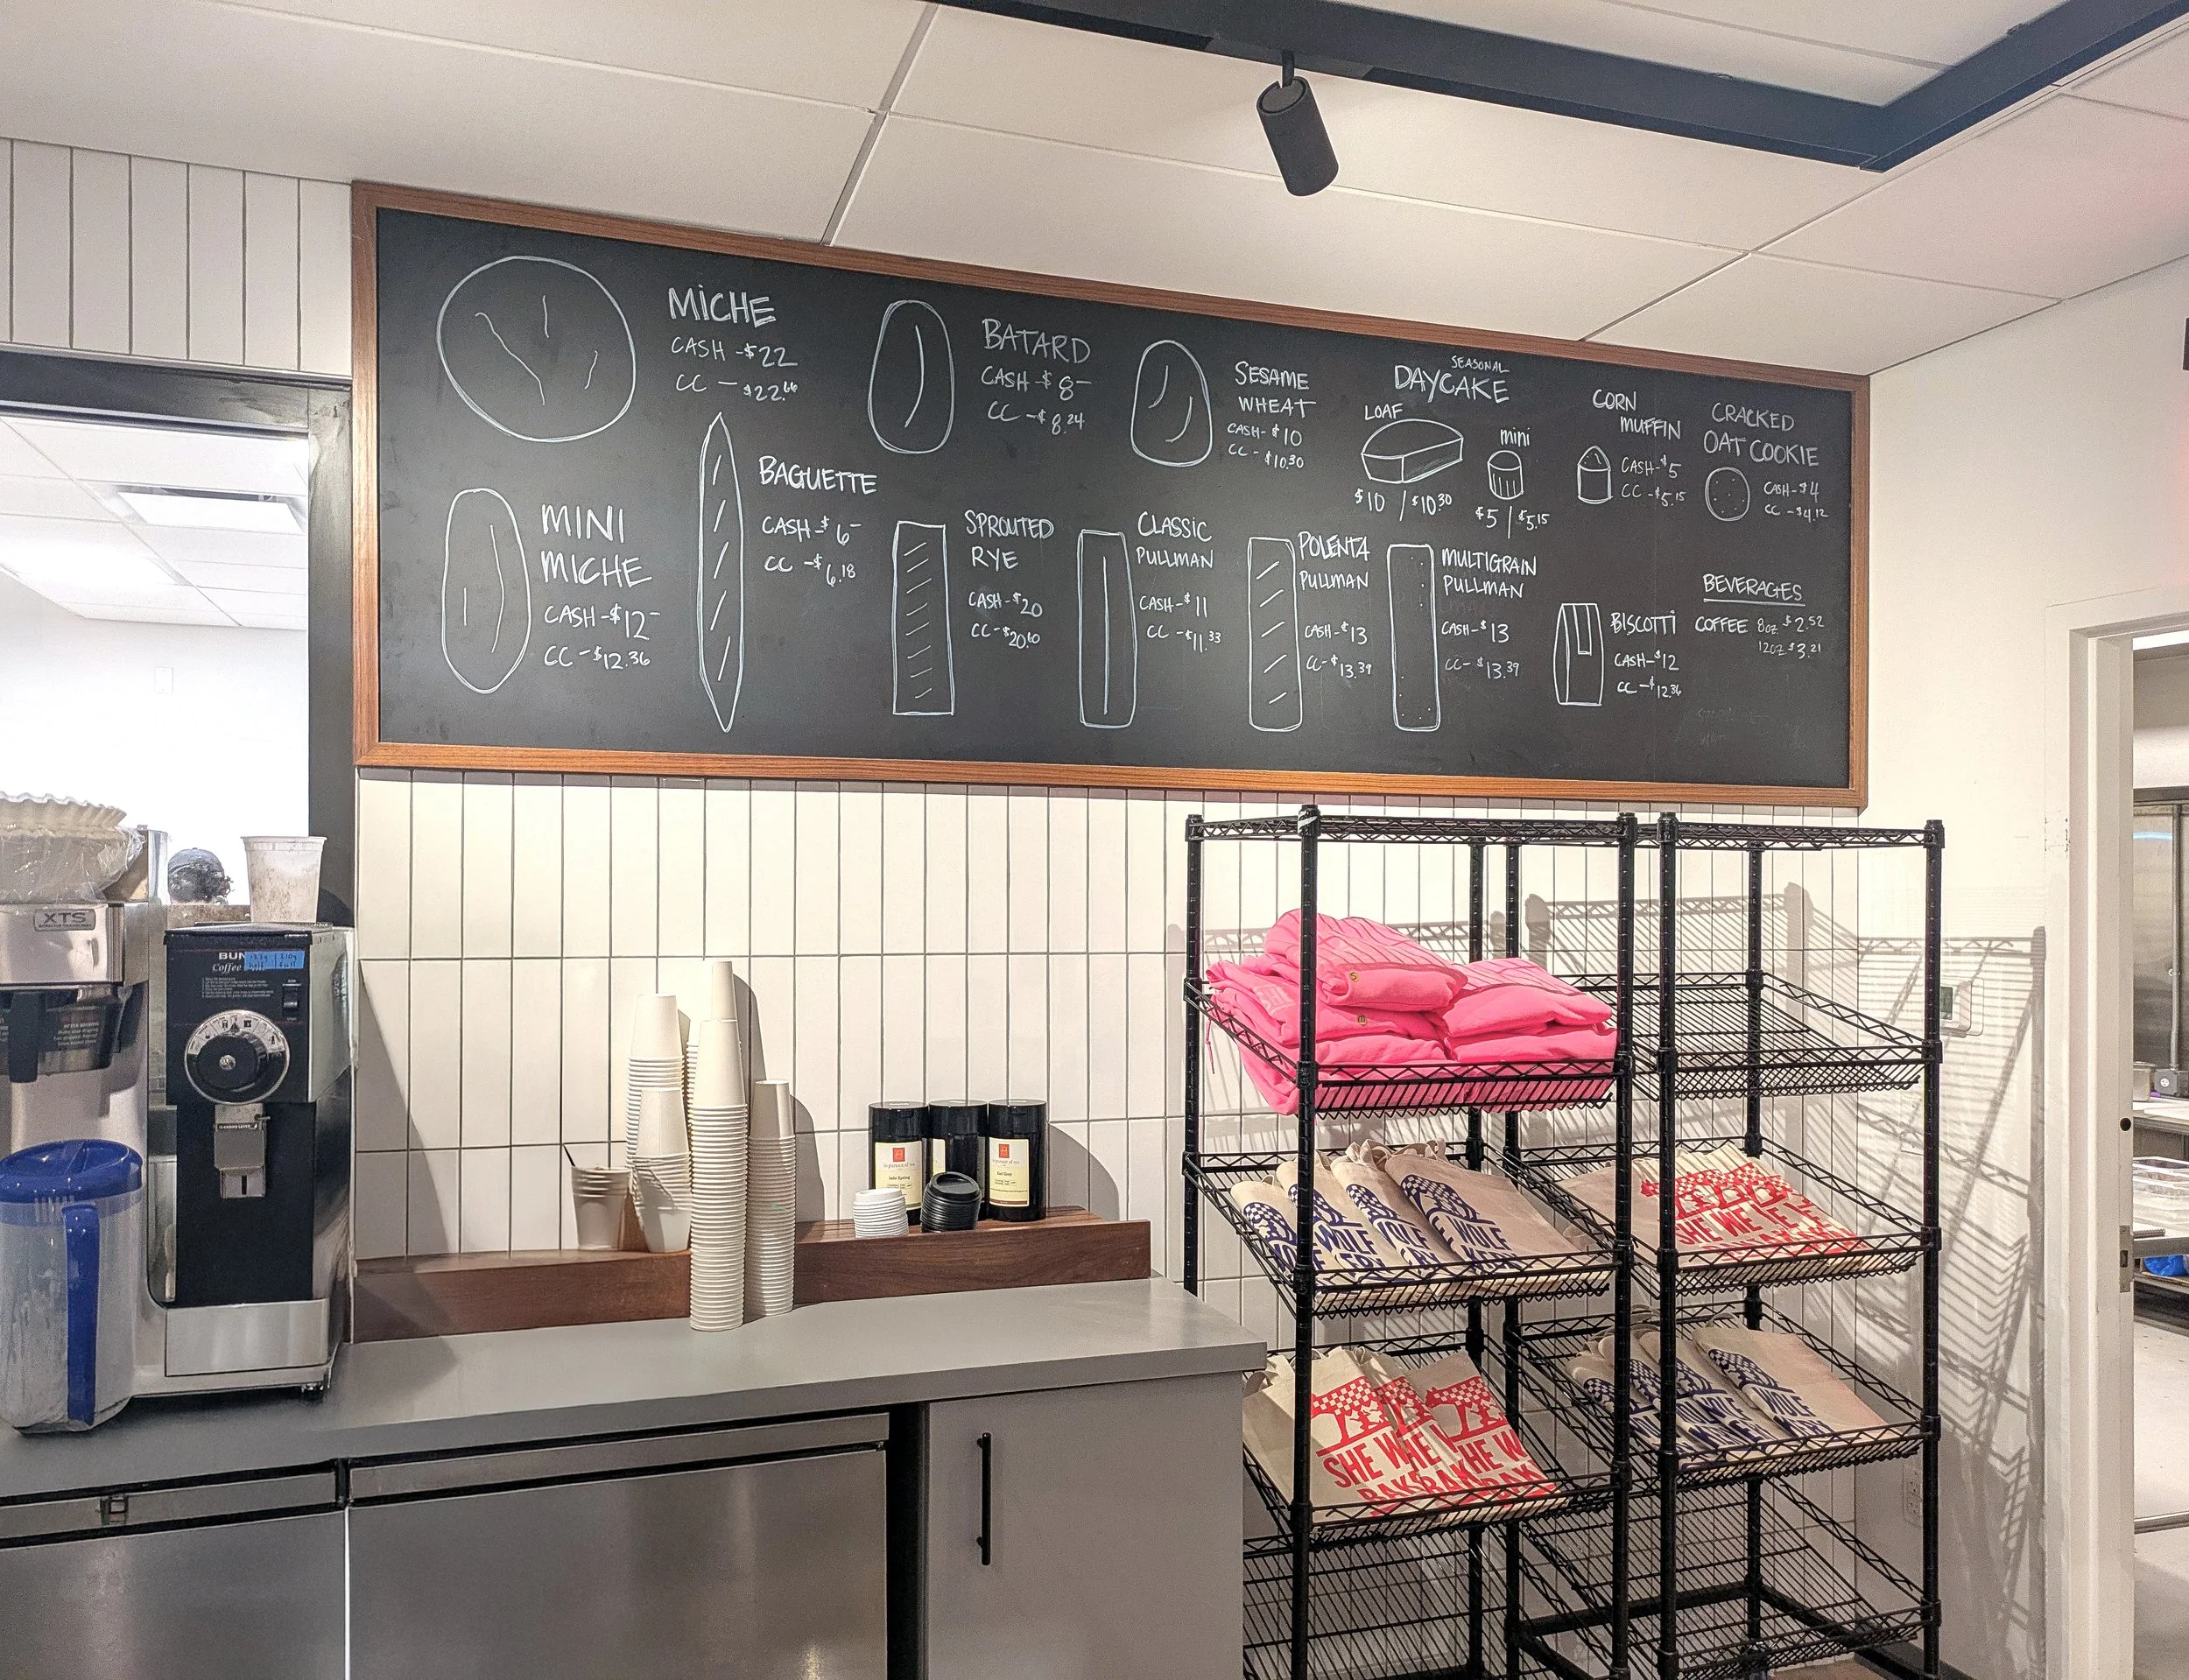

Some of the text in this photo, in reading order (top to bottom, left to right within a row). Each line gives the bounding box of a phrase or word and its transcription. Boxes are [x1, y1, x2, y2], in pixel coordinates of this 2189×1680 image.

[667, 284, 777, 328] MICHE
[671, 336, 726, 362] CASH
[982, 318, 1091, 364] BATARD
[1235, 360, 1310, 390] SESAME
[1451, 355, 1510, 374] SEASONAL
[675, 373, 707, 392] CC
[981, 365, 1031, 392] CASH
[1394, 364, 1510, 404] DAYCAKE
[987, 400, 1021, 422] CC
[1237, 396, 1317, 419] WHEAT
[1364, 402, 1404, 420] LOAF
[1592, 389, 1636, 412] CORN
[1620, 415, 1681, 440] MUFFIN
[1709, 402, 1795, 433] CRACKED
[1703, 429, 1819, 467] OAT COOKIE
[758, 455, 877, 496] BAGUETTE
[1621, 483, 1642, 498] CC
[541, 503, 624, 544] MINI
[964, 509, 1055, 540] SPROUTED
[1137, 510, 1213, 543] CLASSIC
[971, 545, 1019, 573] RYE
[1136, 545, 1214, 569] PULLMAN
[1297, 531, 1371, 562] POLENTA
[540, 550, 653, 588] MICHE
[764, 555, 793, 573] CC
[1441, 547, 1537, 578] MULTIGRAIN
[1299, 570, 1369, 591] PULLMAN
[1442, 574, 1524, 599] PULLMAN
[1702, 573, 1803, 601] BEVERAGES
[544, 604, 595, 629] CASH
[1609, 609, 1676, 636] BISCOTTI
[1694, 615, 1749, 634] COFFEE
[970, 622, 991, 638] CC
[1146, 624, 1170, 639] CC
[544, 645, 574, 667] CC
[44, 912, 86, 924] XTS
[212, 962, 242, 974] Coffee
[219, 952, 246, 960] BUN
[1446, 1216, 1508, 1252] WOLF
[1676, 1216, 1723, 1246] SHE
[1752, 1386, 1817, 1417] WOLF
[1323, 1445, 1383, 1488] SHE
